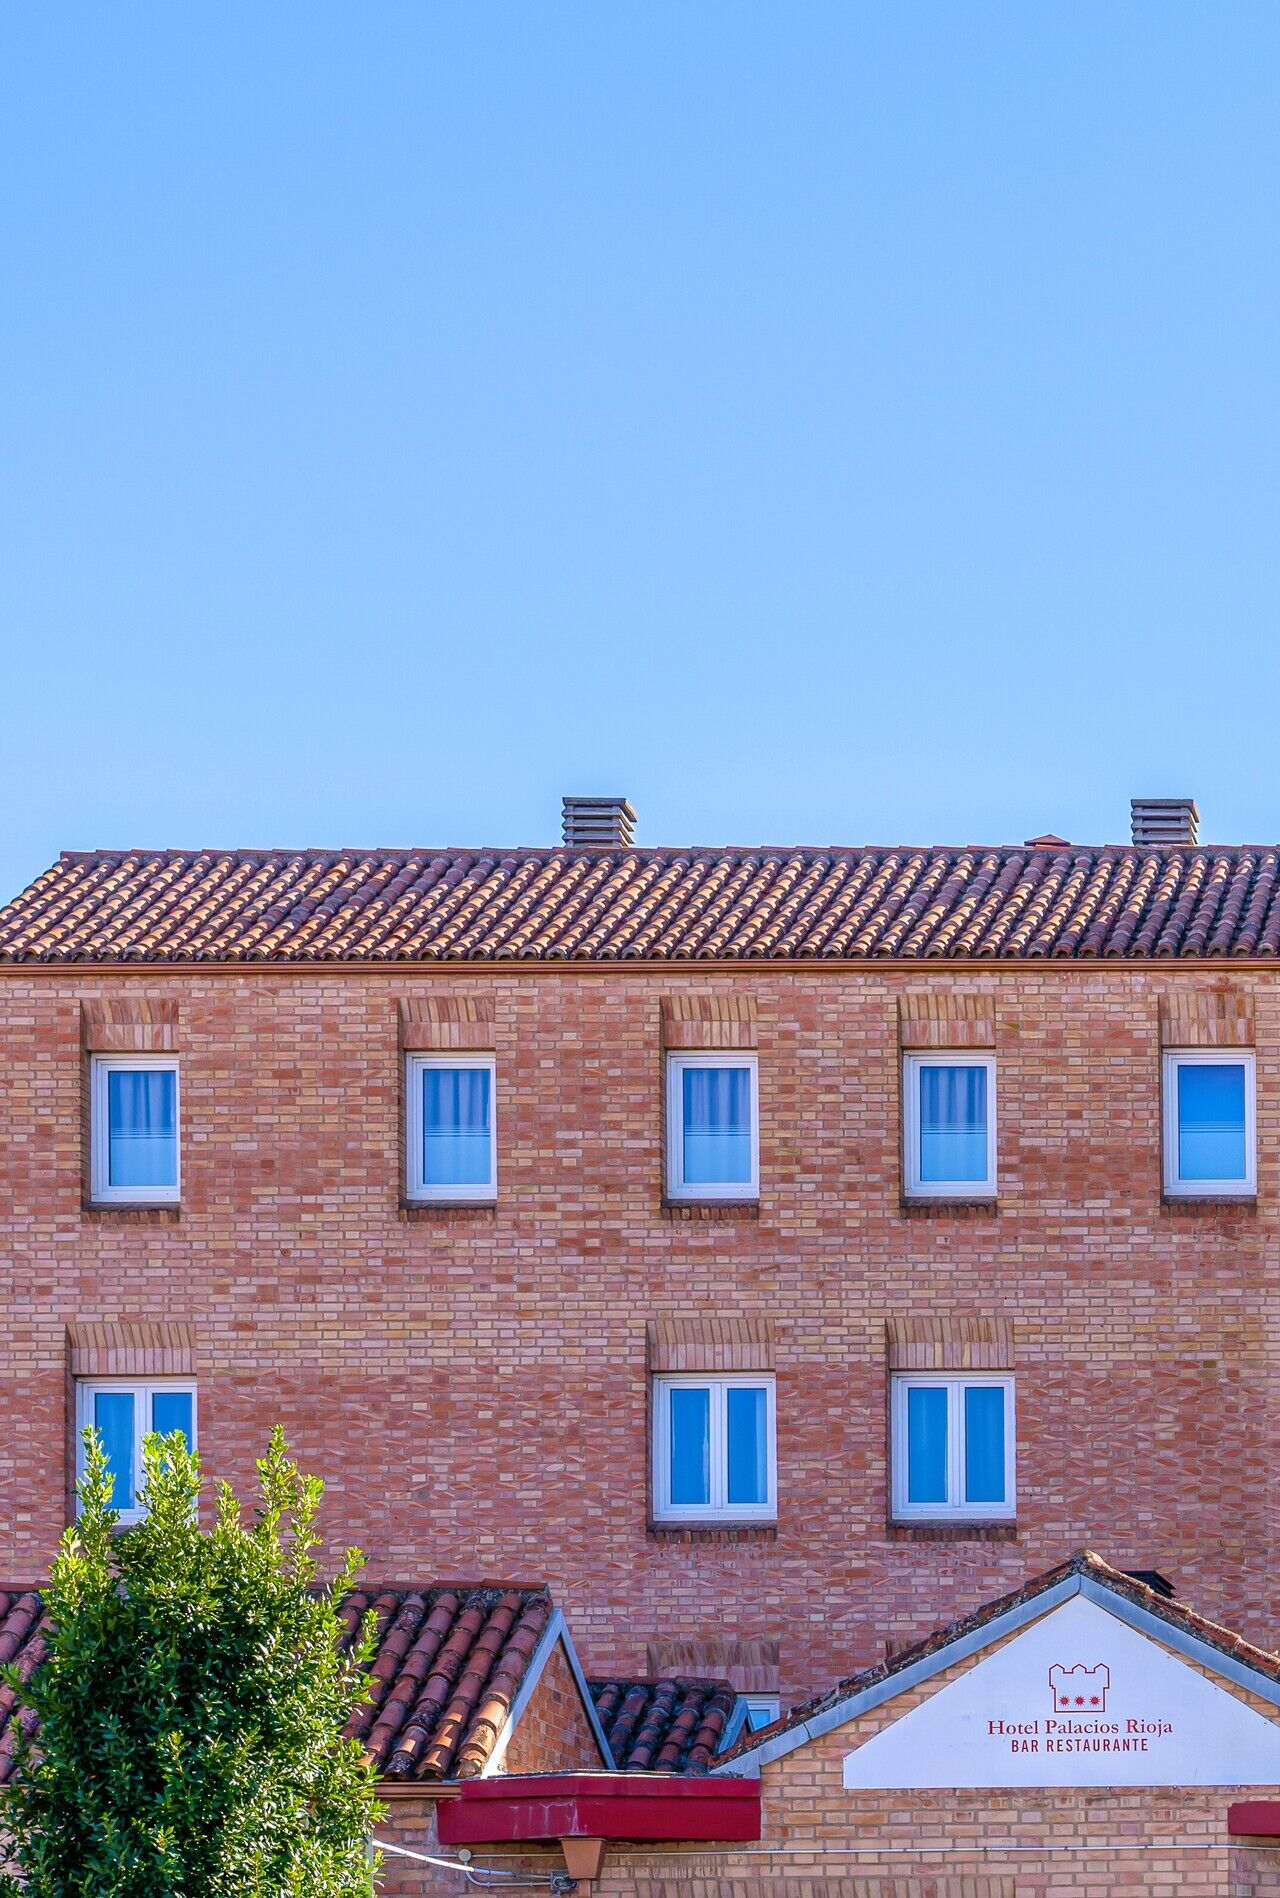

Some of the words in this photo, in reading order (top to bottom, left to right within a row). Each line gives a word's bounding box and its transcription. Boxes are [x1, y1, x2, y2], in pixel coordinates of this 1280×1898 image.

[987, 1720, 1040, 1735] Hotel
[1044, 1719, 1119, 1734] Palacios
[1126, 1718, 1173, 1737] Rioja
[1011, 1739, 1039, 1752] BAR
[1046, 1738, 1148, 1752] RESTAURANTE
